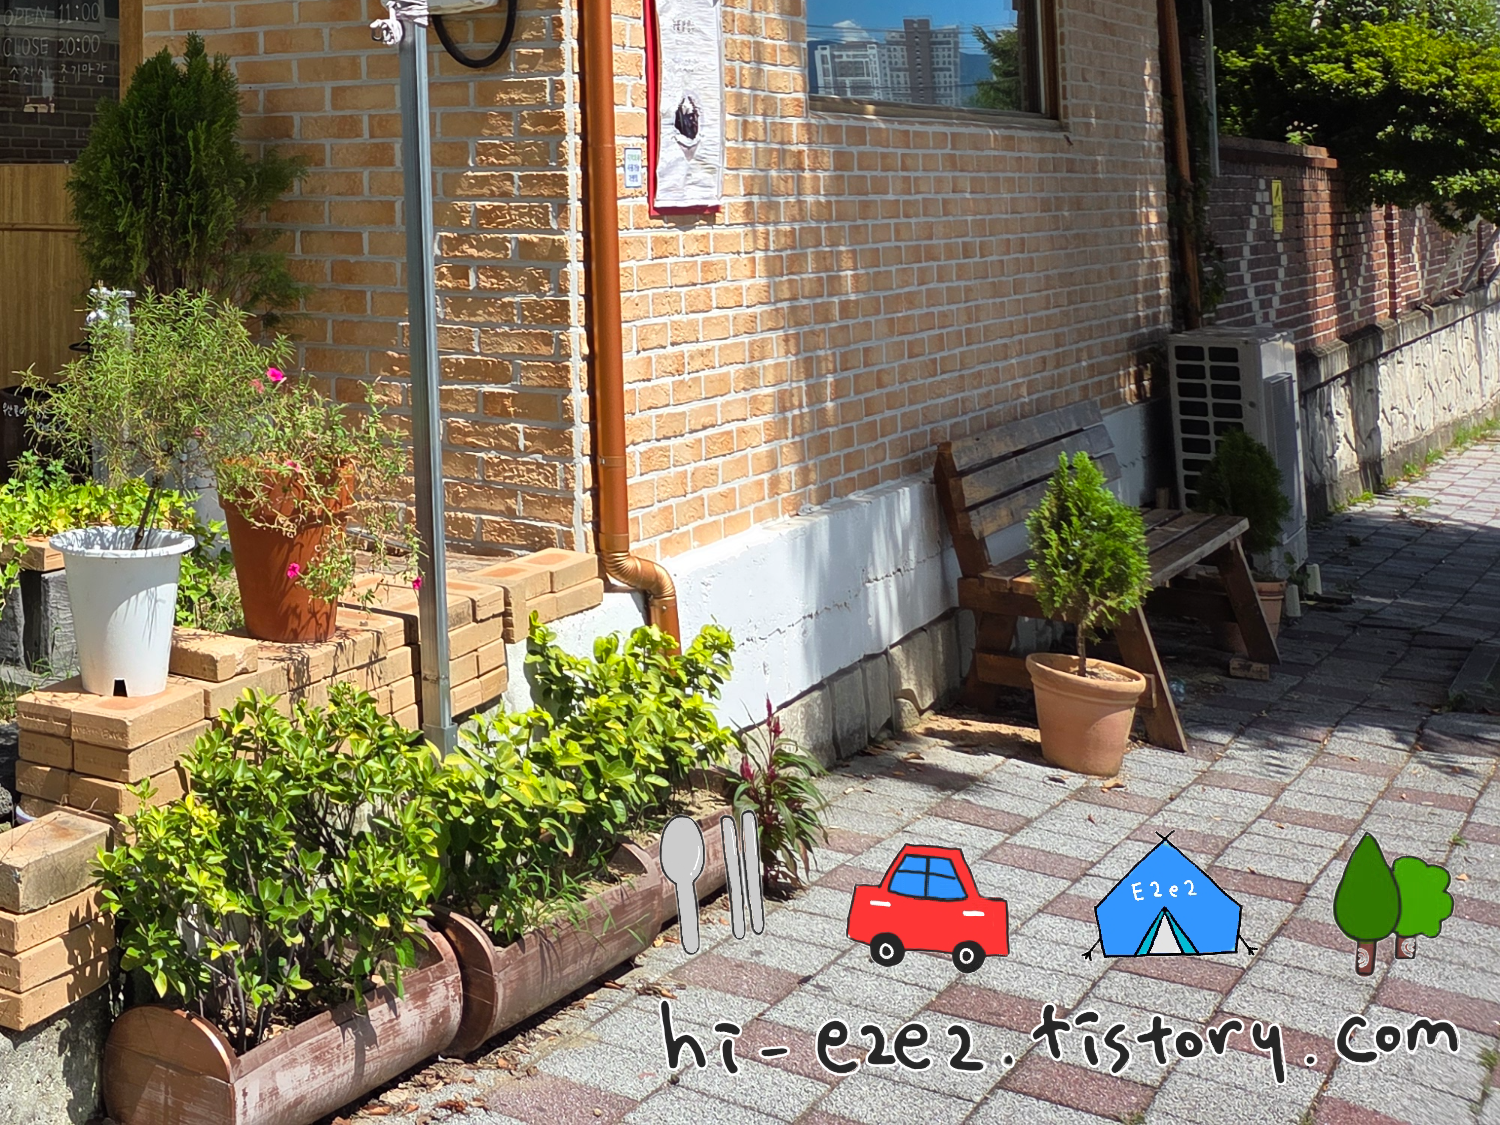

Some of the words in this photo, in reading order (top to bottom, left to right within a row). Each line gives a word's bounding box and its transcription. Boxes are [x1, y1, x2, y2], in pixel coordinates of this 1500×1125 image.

[3, 5, 48, 26] OPEN
[58, 2, 100, 24] 11:00
[3, 37, 49, 58] CLOSE
[58, 35, 100, 56] 20:00
[58, 62, 108, 83] 조기마감
